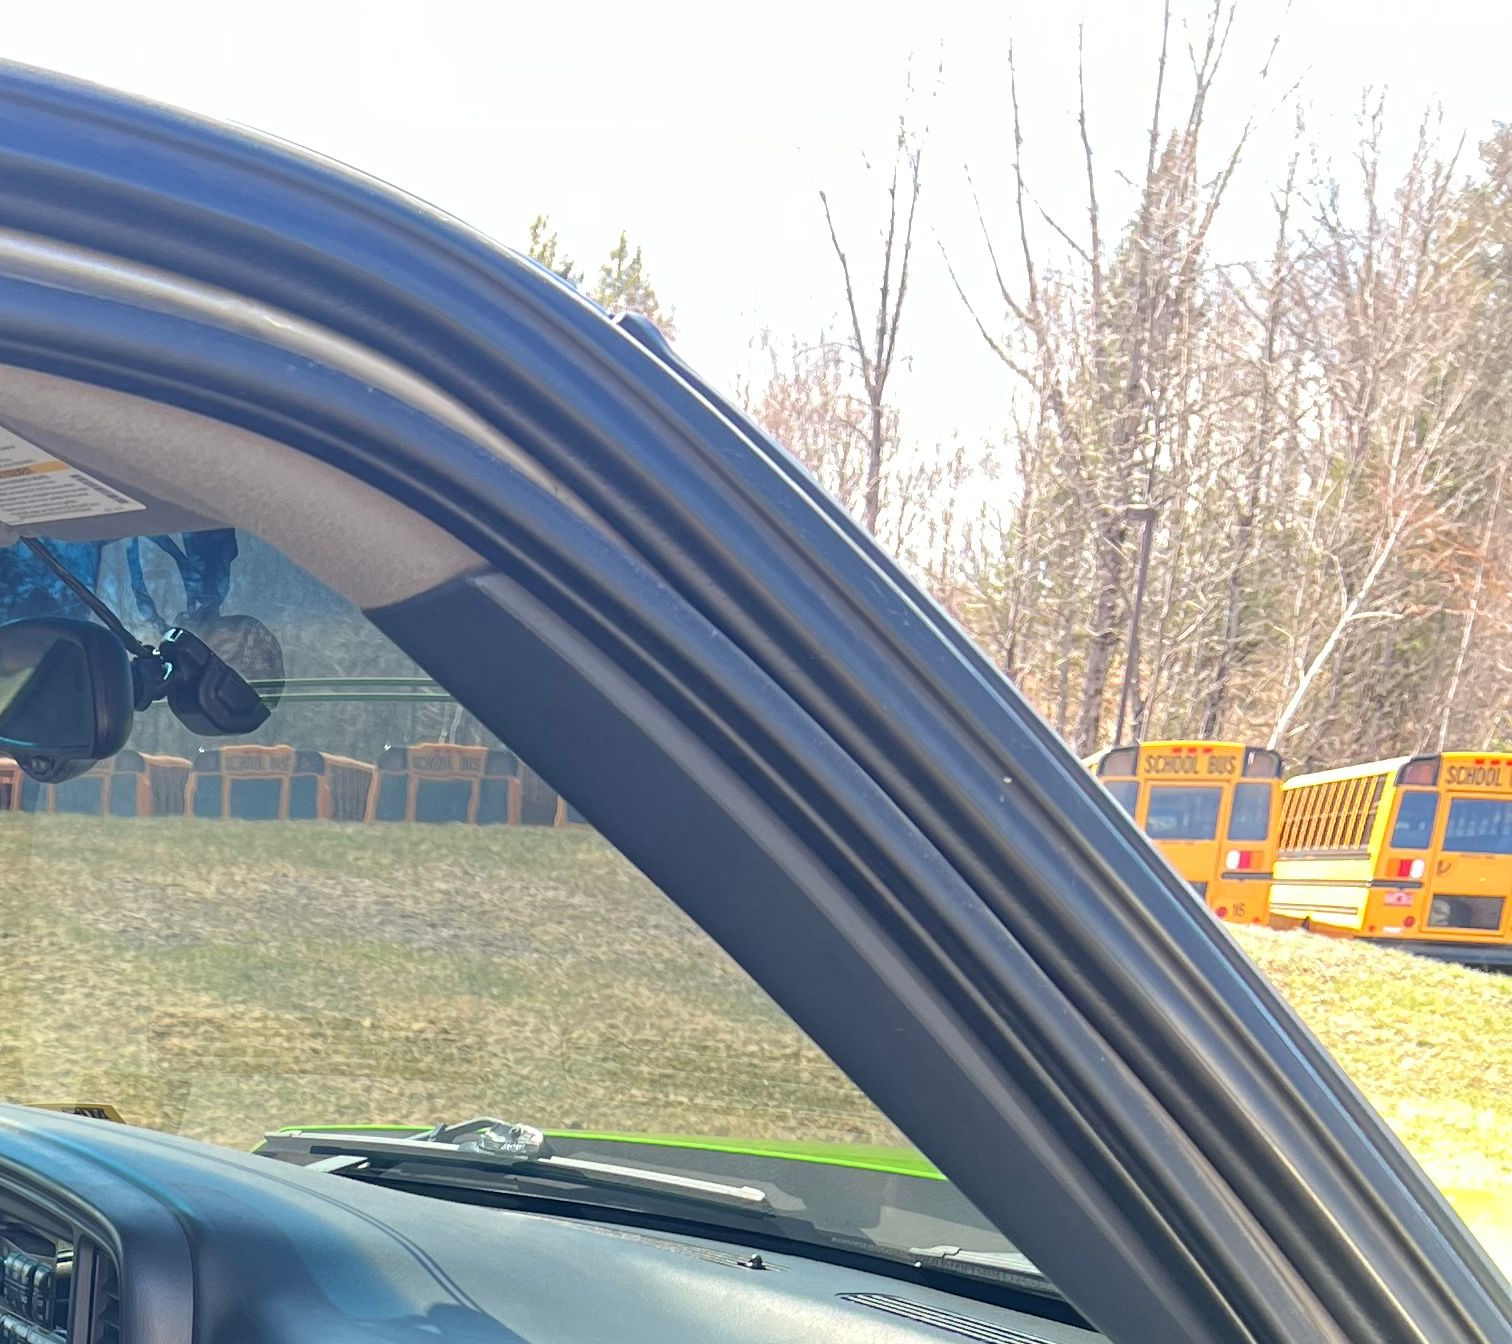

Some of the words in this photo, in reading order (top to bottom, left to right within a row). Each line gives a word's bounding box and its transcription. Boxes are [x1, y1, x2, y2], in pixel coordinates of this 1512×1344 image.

[1144, 755, 1199, 774] SCHOOL
[1207, 755, 1237, 774] BUS
[1445, 766, 1502, 787] SCHOOL
